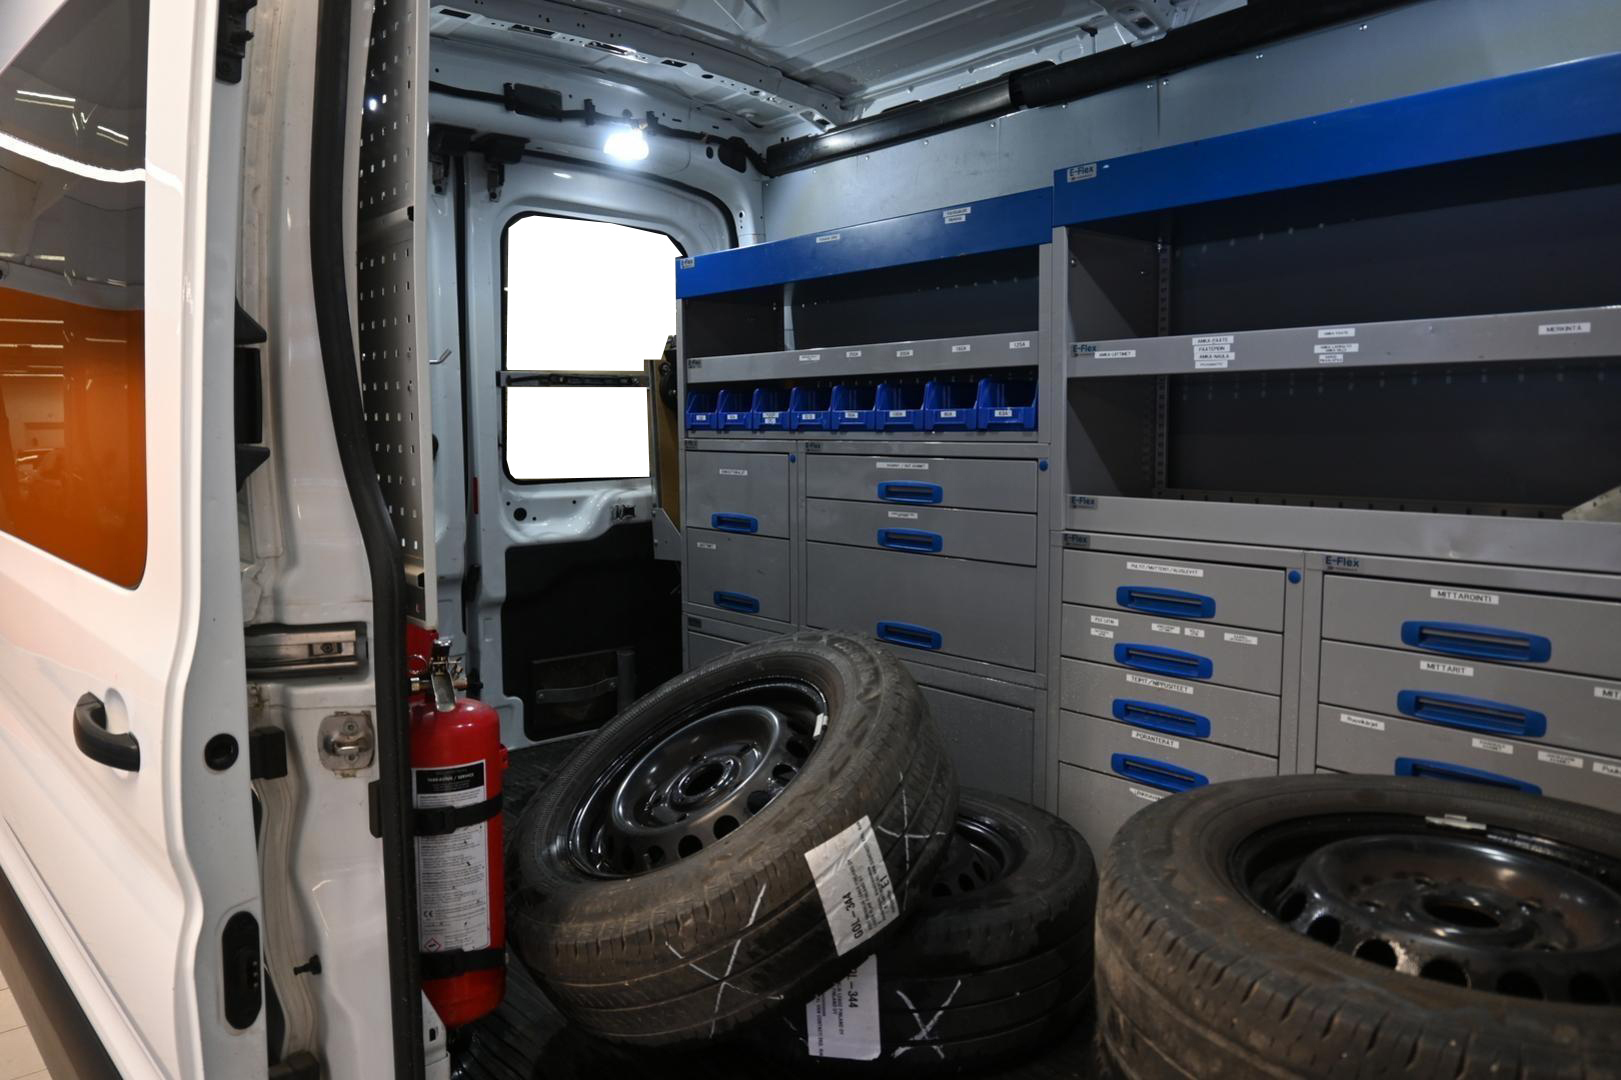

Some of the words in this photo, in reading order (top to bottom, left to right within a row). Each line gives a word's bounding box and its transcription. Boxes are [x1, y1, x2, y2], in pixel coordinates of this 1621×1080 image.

[1069, 166, 1094, 177] E-Flex
[1072, 344, 1097, 352] E-Flex
[1071, 496, 1095, 505] E-Flex
[1064, 534, 1088, 544] E-Flex
[1325, 556, 1359, 568] E-Flex
[1437, 590, 1493, 602] MITTAROINTI
[1427, 663, 1466, 674] MITTARIT
[879, 875, 889, 888] E1
